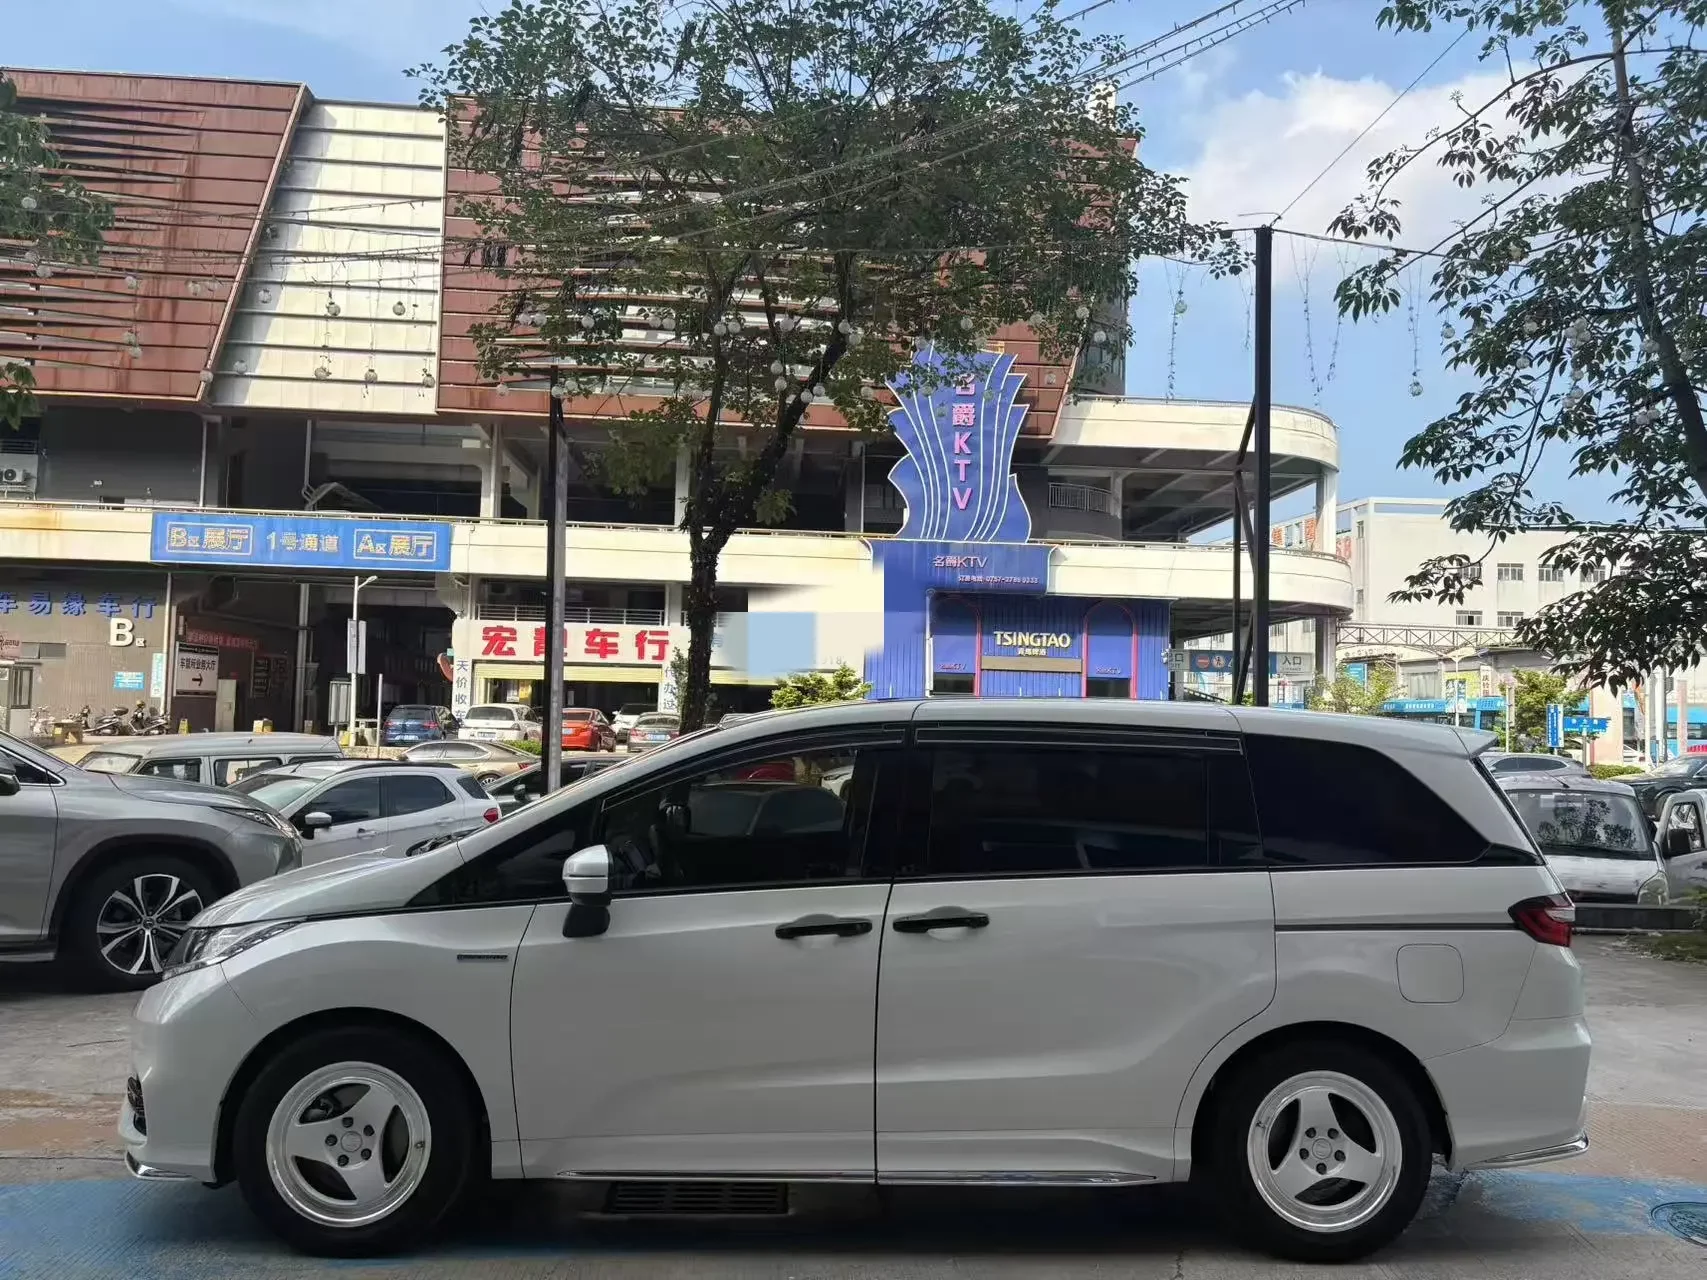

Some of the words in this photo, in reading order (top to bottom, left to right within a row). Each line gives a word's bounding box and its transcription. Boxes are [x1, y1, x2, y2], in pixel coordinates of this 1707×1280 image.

[952, 373, 975, 511] 名爵KTV
[266, 531, 340, 552] 1号通道
[932, 555, 987, 568] 名爵KTV
[993, 631, 1071, 648] TSINGTAO
[1282, 655, 1302, 665] 入口
